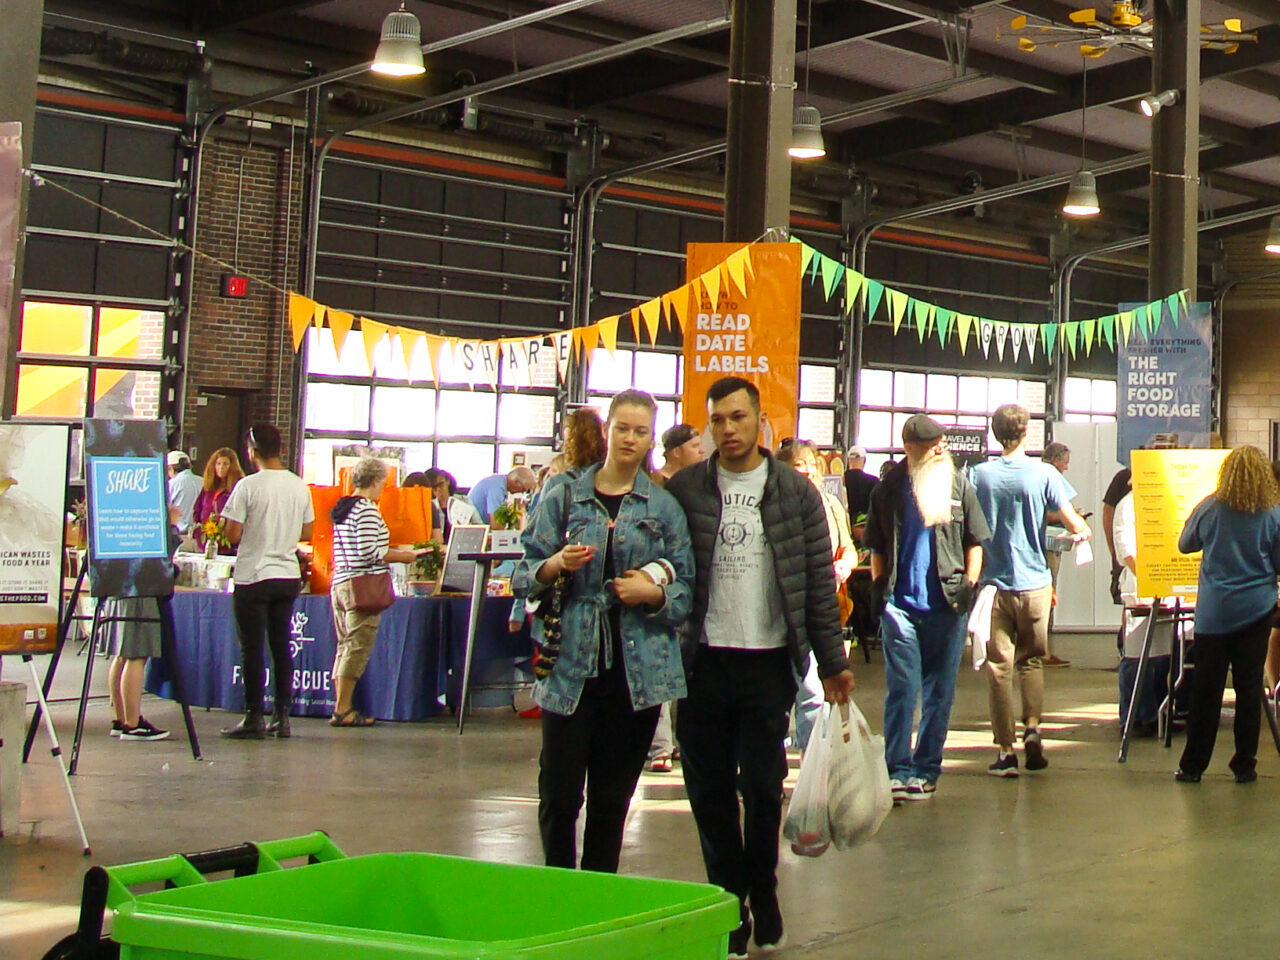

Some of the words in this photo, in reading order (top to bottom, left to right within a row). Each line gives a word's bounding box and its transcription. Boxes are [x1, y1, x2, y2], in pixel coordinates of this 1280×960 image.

[726, 302, 738, 310] TO
[696, 313, 750, 330] READ
[696, 334, 746, 351] DATE
[982, 323, 1036, 347] GROW
[463, 333, 568, 371] SHARE
[695, 355, 769, 372] LABELS
[1128, 356, 1158, 370] THE
[1128, 372, 1177, 385] RIGHT
[1128, 387, 1174, 401] FOOD
[1127, 403, 1201, 417] STORAGE
[946, 435, 981, 443] AVELING
[948, 443, 980, 451] IENCE
[106, 467, 153, 494] SHARE
[292, 669, 331, 691] SCUE
